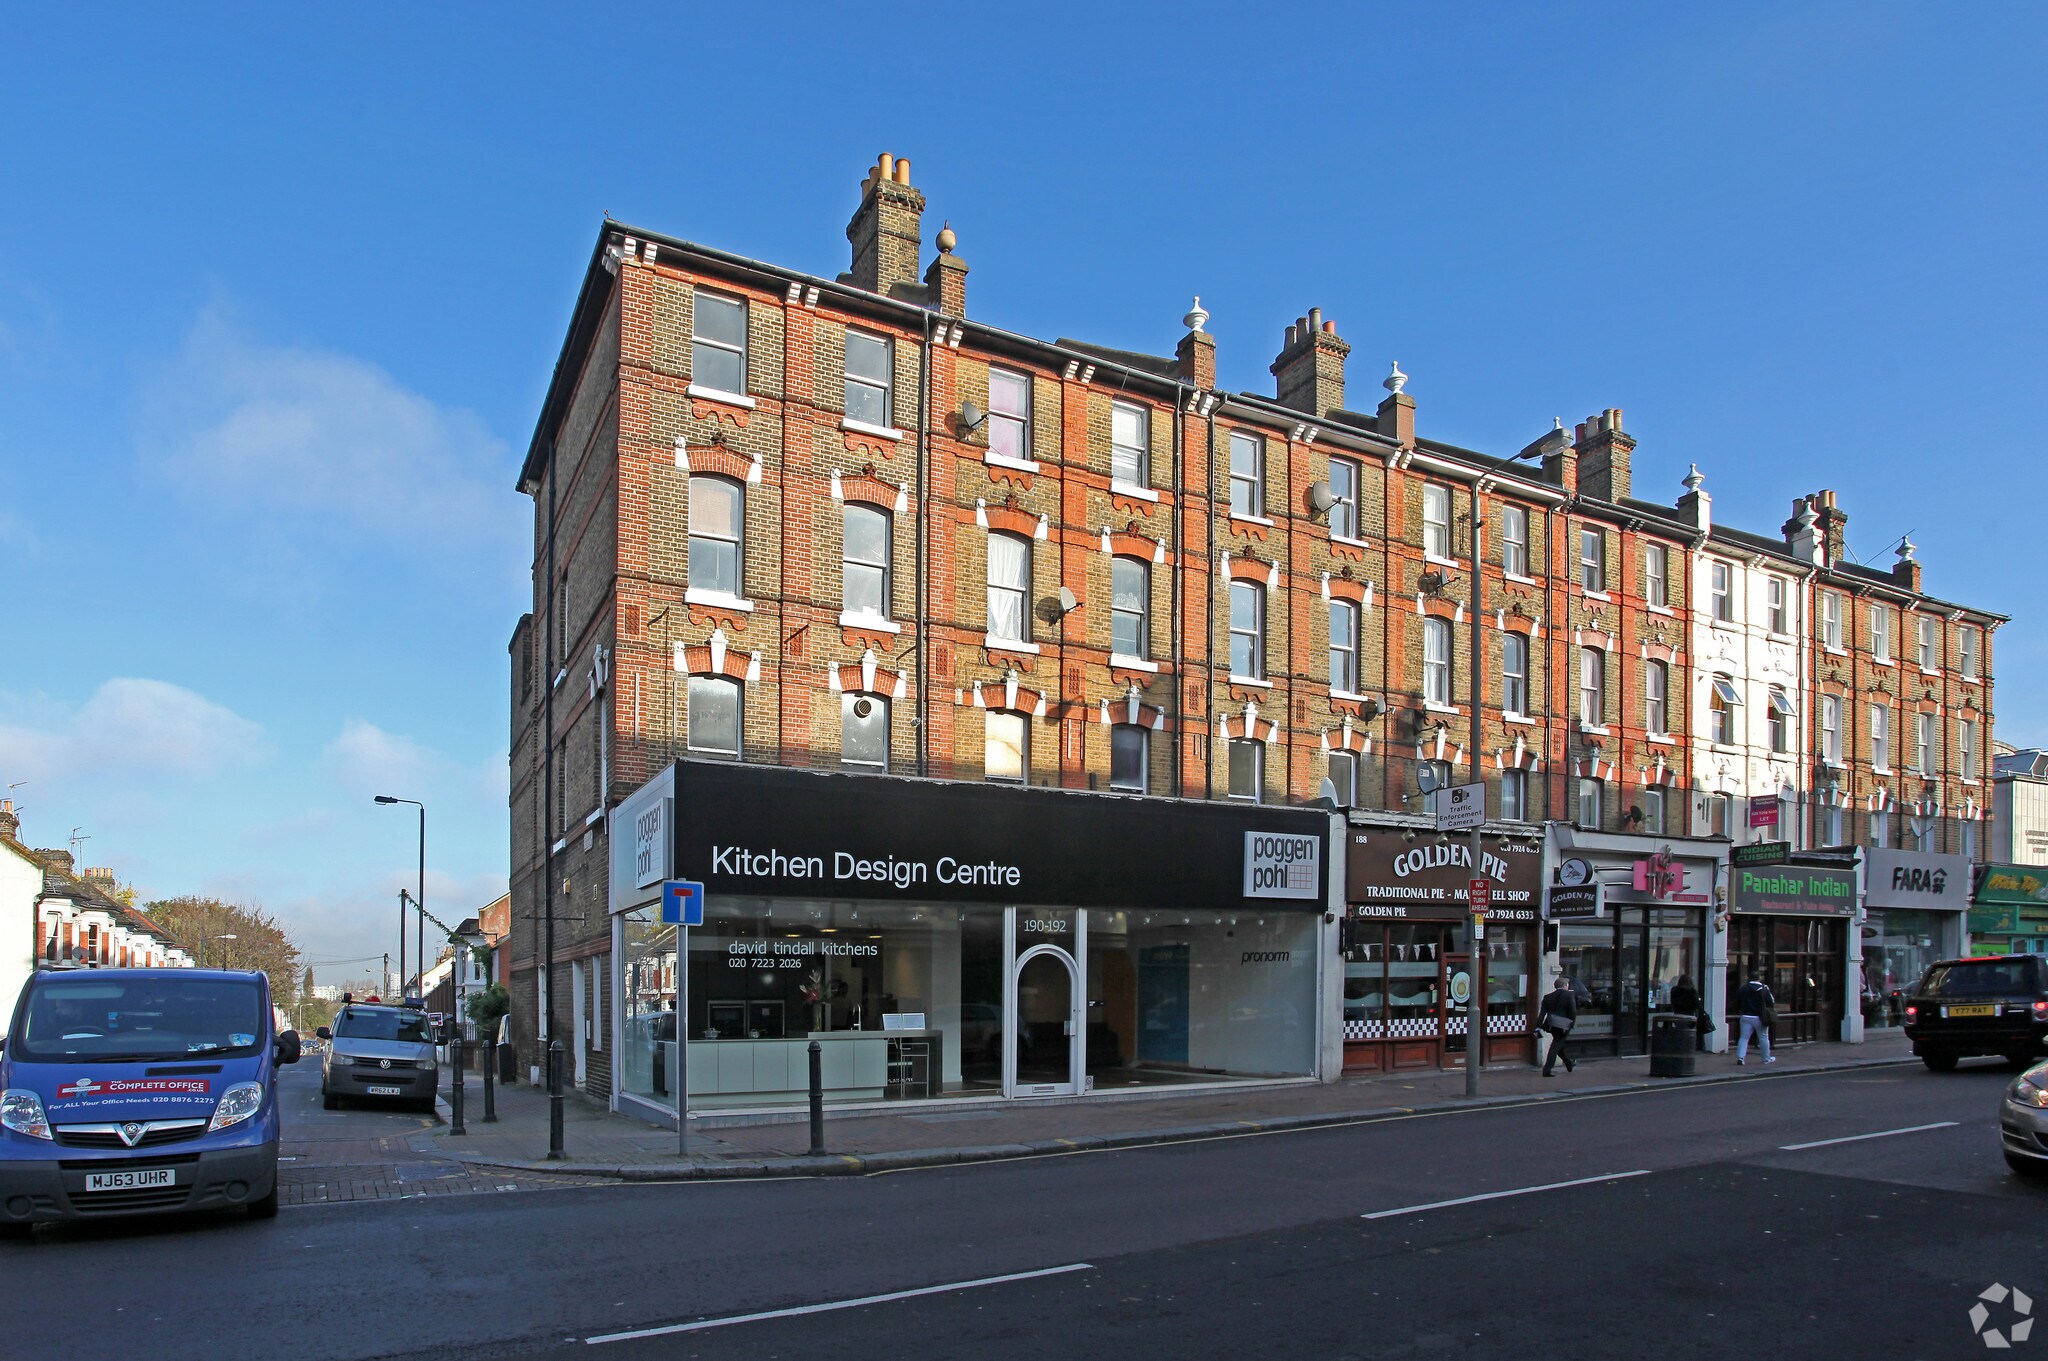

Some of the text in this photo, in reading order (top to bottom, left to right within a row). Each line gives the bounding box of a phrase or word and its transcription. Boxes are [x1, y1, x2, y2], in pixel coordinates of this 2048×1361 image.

[1450, 804, 1472, 813] Traffic
[1440, 810, 1482, 822] Enforcement
[637, 805, 661, 848] poggen
[1448, 819, 1474, 827] Camera
[1355, 835, 1367, 844] 188
[1253, 836, 1313, 863] poggen
[1511, 844, 1525, 853] 7924
[1740, 845, 1780, 854] INDIAN
[1736, 851, 1784, 861] CUISINE
[637, 843, 651, 883] pohl
[712, 846, 1021, 889] Kitchen Design Centre
[1393, 844, 1508, 883] GOLDEN PIE
[1253, 864, 1288, 892] pohl
[1742, 872, 1849, 897] Panahar Indian
[1892, 867, 1931, 893] FARA
[1367, 886, 1429, 898] TRADITIONAL
[1431, 888, 1445, 899] PIE
[1454, 888, 1470, 900] MA
[1492, 890, 1506, 900] EEL
[1507, 890, 1530, 901] SHOP
[1552, 892, 1596, 903] GOLDEN PIE
[1358, 905, 1407, 917] GOLDEN PIE
[1496, 910, 1514, 919] 7924
[1516, 910, 1534, 920] 6333
[1023, 919, 1067, 933] 190-192
[728, 940, 878, 957] david tindall kitchens
[728, 958, 802, 968] 020 7223 2026
[1241, 951, 1290, 965] pronorm
[1972, 1006, 1987, 1014] RAT
[110, 1081, 166, 1091] COMPLETE
[168, 1081, 205, 1090] OFFICE
[93, 1171, 168, 1188] MJ63 UHR
